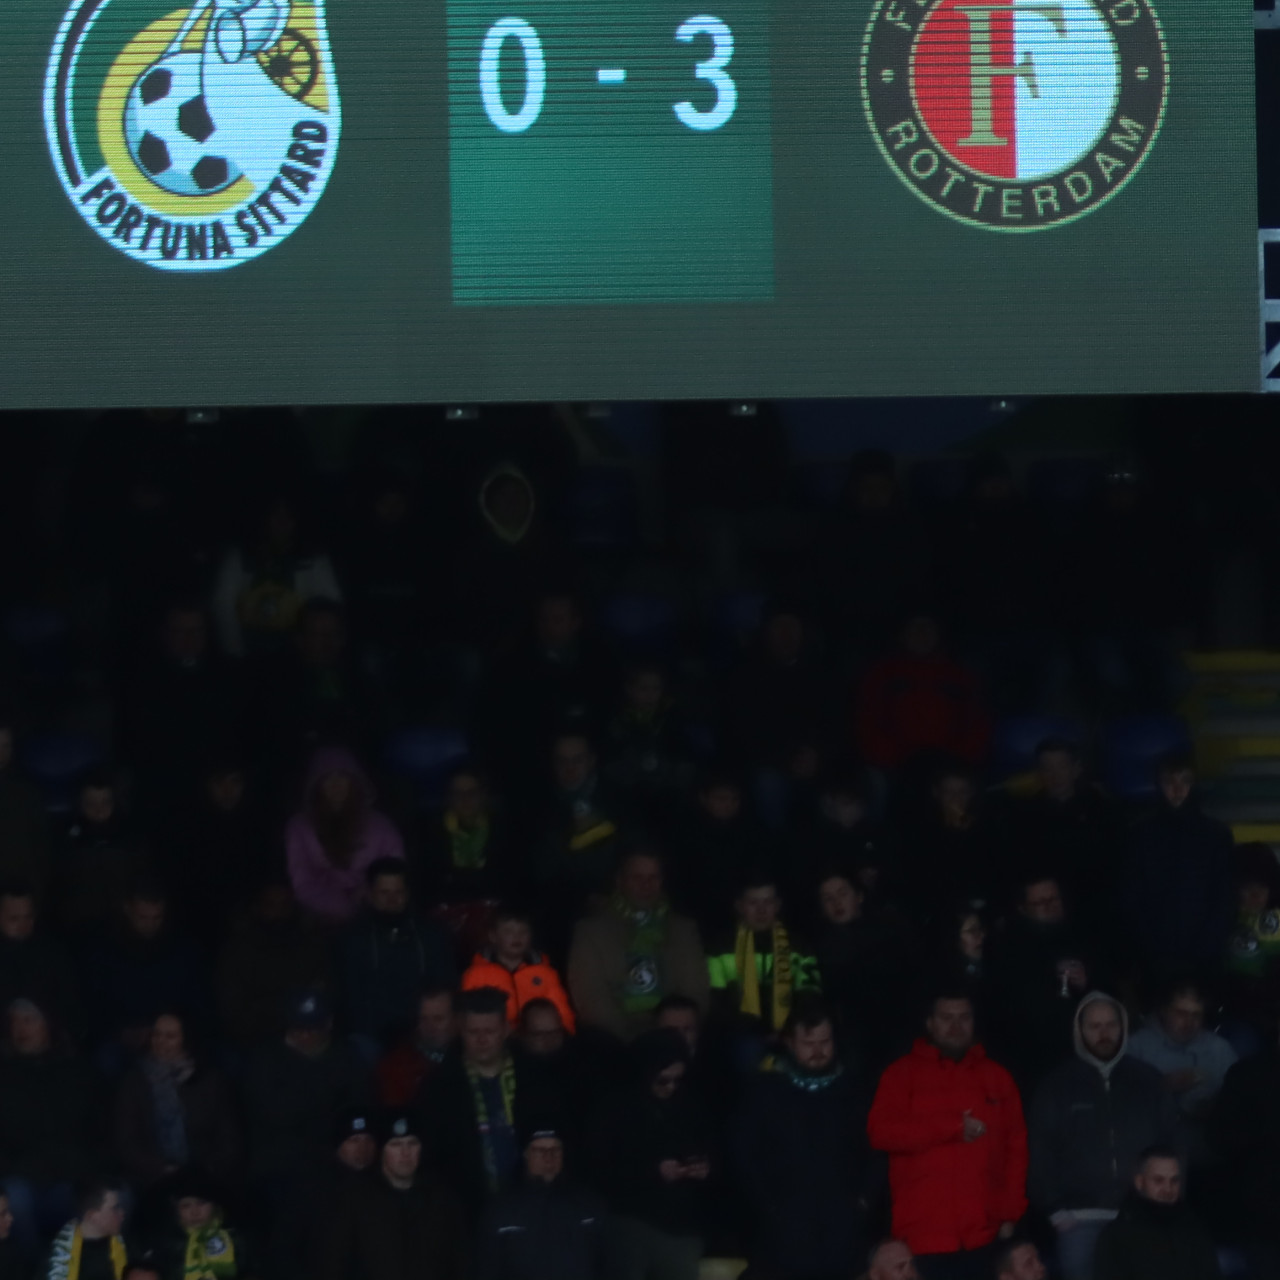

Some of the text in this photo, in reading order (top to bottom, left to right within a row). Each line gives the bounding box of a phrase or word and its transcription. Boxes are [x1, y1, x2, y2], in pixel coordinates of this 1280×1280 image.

[479, 17, 546, 133] 0
[673, 15, 738, 131] 3
[80, 120, 328, 260] FORTUNA SITTARD
[886, 115, 1145, 218] ROTTERDAM
